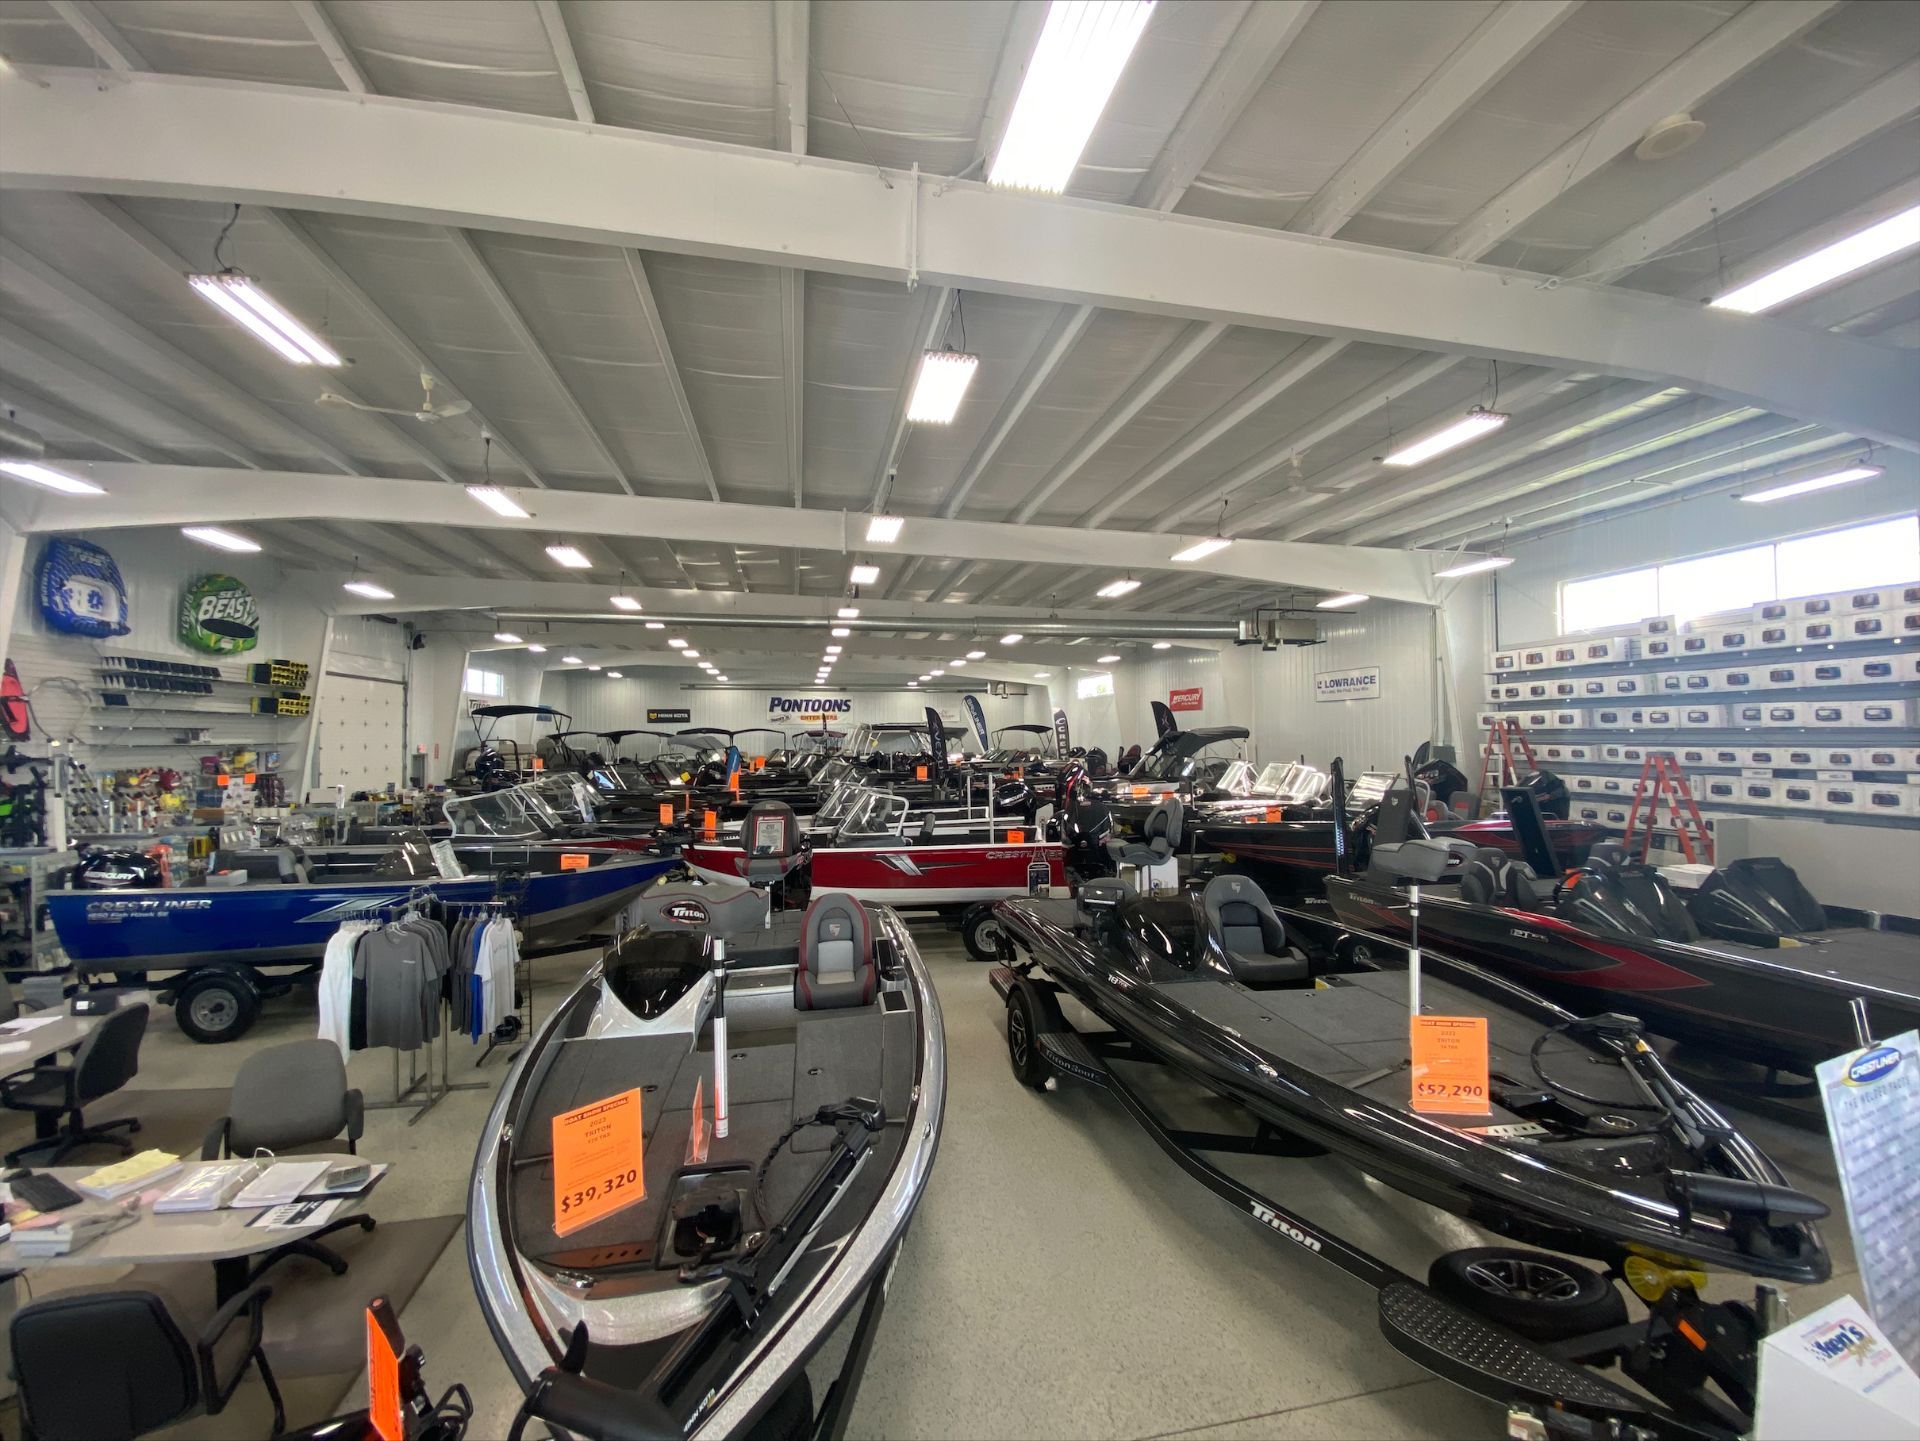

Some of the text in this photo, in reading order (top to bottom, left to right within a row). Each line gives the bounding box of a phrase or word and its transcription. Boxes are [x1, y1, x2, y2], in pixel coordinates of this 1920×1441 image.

[198, 595, 253, 621] BEAST
[1324, 675, 1377, 688] LOWRANCE
[769, 697, 852, 712] PONTOONS
[1172, 690, 1202, 705] MERCURY
[1058, 726, 1068, 761] CREST
[83, 871, 137, 880] MERCURY
[86, 899, 213, 912] CRESTLINER
[1348, 892, 1374, 905] Triton
[671, 906, 705, 919] Triton
[1850, 1051, 1901, 1079] CRESTLINER
[584, 1124, 612, 1138] TRITON
[560, 1169, 637, 1214] $39,320
[1249, 1200, 1322, 1252] Triton
